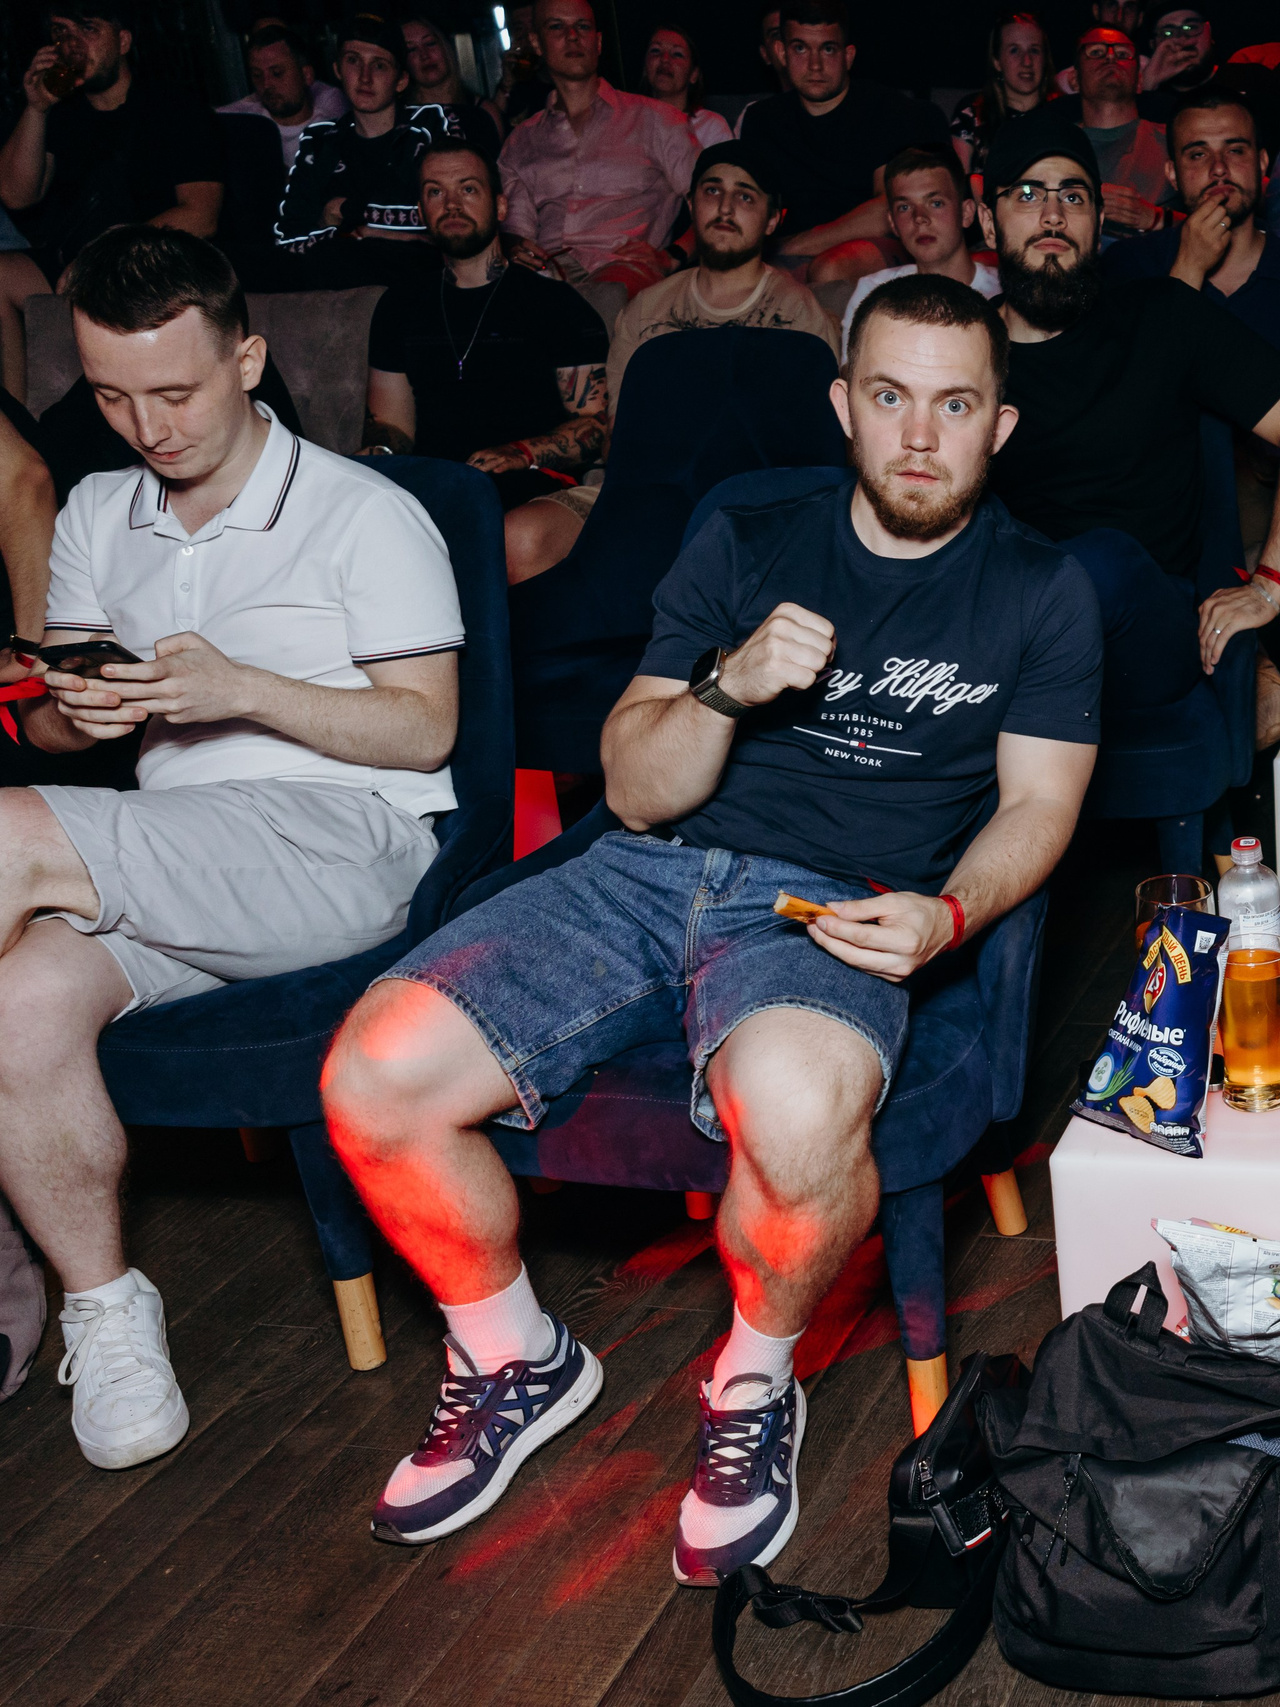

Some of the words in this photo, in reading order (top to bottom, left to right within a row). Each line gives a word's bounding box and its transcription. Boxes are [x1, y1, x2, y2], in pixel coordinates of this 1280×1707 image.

[868, 656, 999, 716] Hilfiger
[820, 712, 903, 731] ESTABLISHED
[846, 726, 874, 738] 1985
[824, 747, 851, 760] NEW
[853, 753, 882, 768] YORK
[1171, 952, 1188, 981] ДЕНЬ
